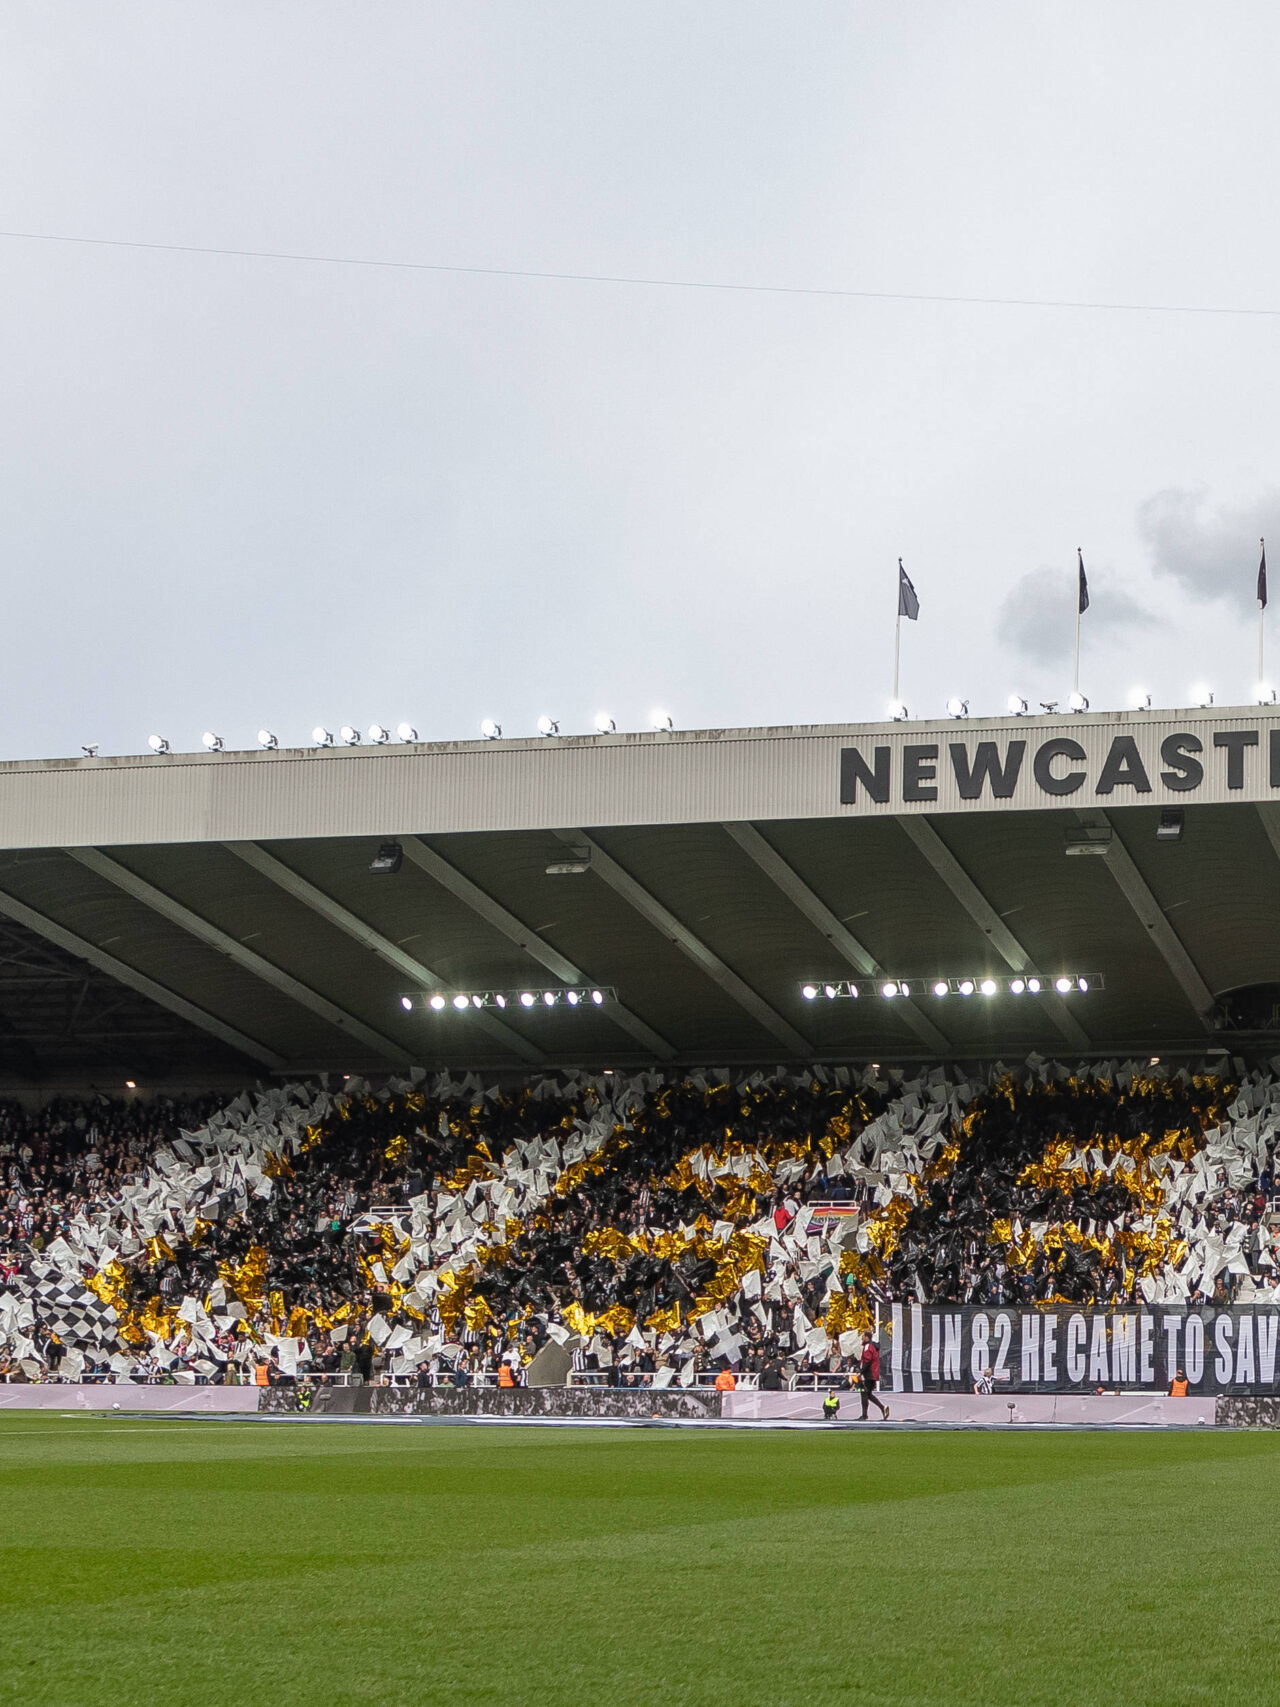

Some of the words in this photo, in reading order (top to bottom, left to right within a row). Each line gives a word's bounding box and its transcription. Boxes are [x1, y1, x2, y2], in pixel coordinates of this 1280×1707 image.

[930, 1314, 962, 1381] IN
[970, 1313, 1012, 1383] 82
[1021, 1314, 1058, 1382] HE
[1066, 1313, 1155, 1383] CAME
[1163, 1313, 1205, 1385] TO
